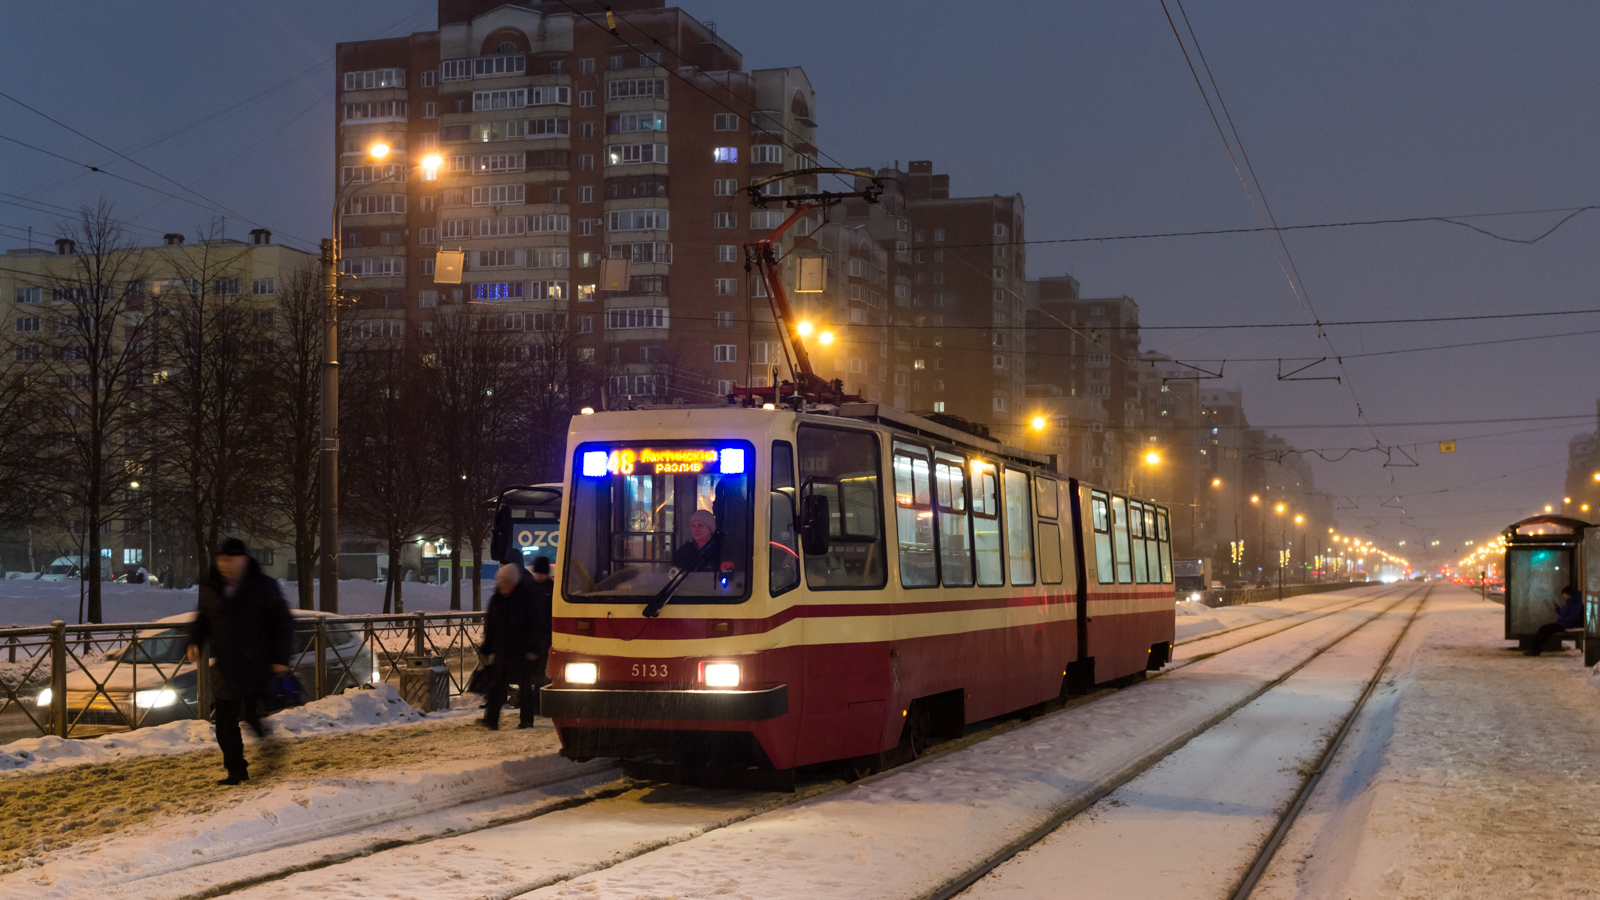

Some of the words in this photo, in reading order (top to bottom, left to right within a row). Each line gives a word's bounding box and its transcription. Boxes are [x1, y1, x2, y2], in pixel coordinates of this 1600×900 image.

[607, 450, 636, 474] 48
[641, 449, 718, 462] Лахтинский
[656, 463, 702, 474] разлив
[631, 664, 668, 677] 5133
